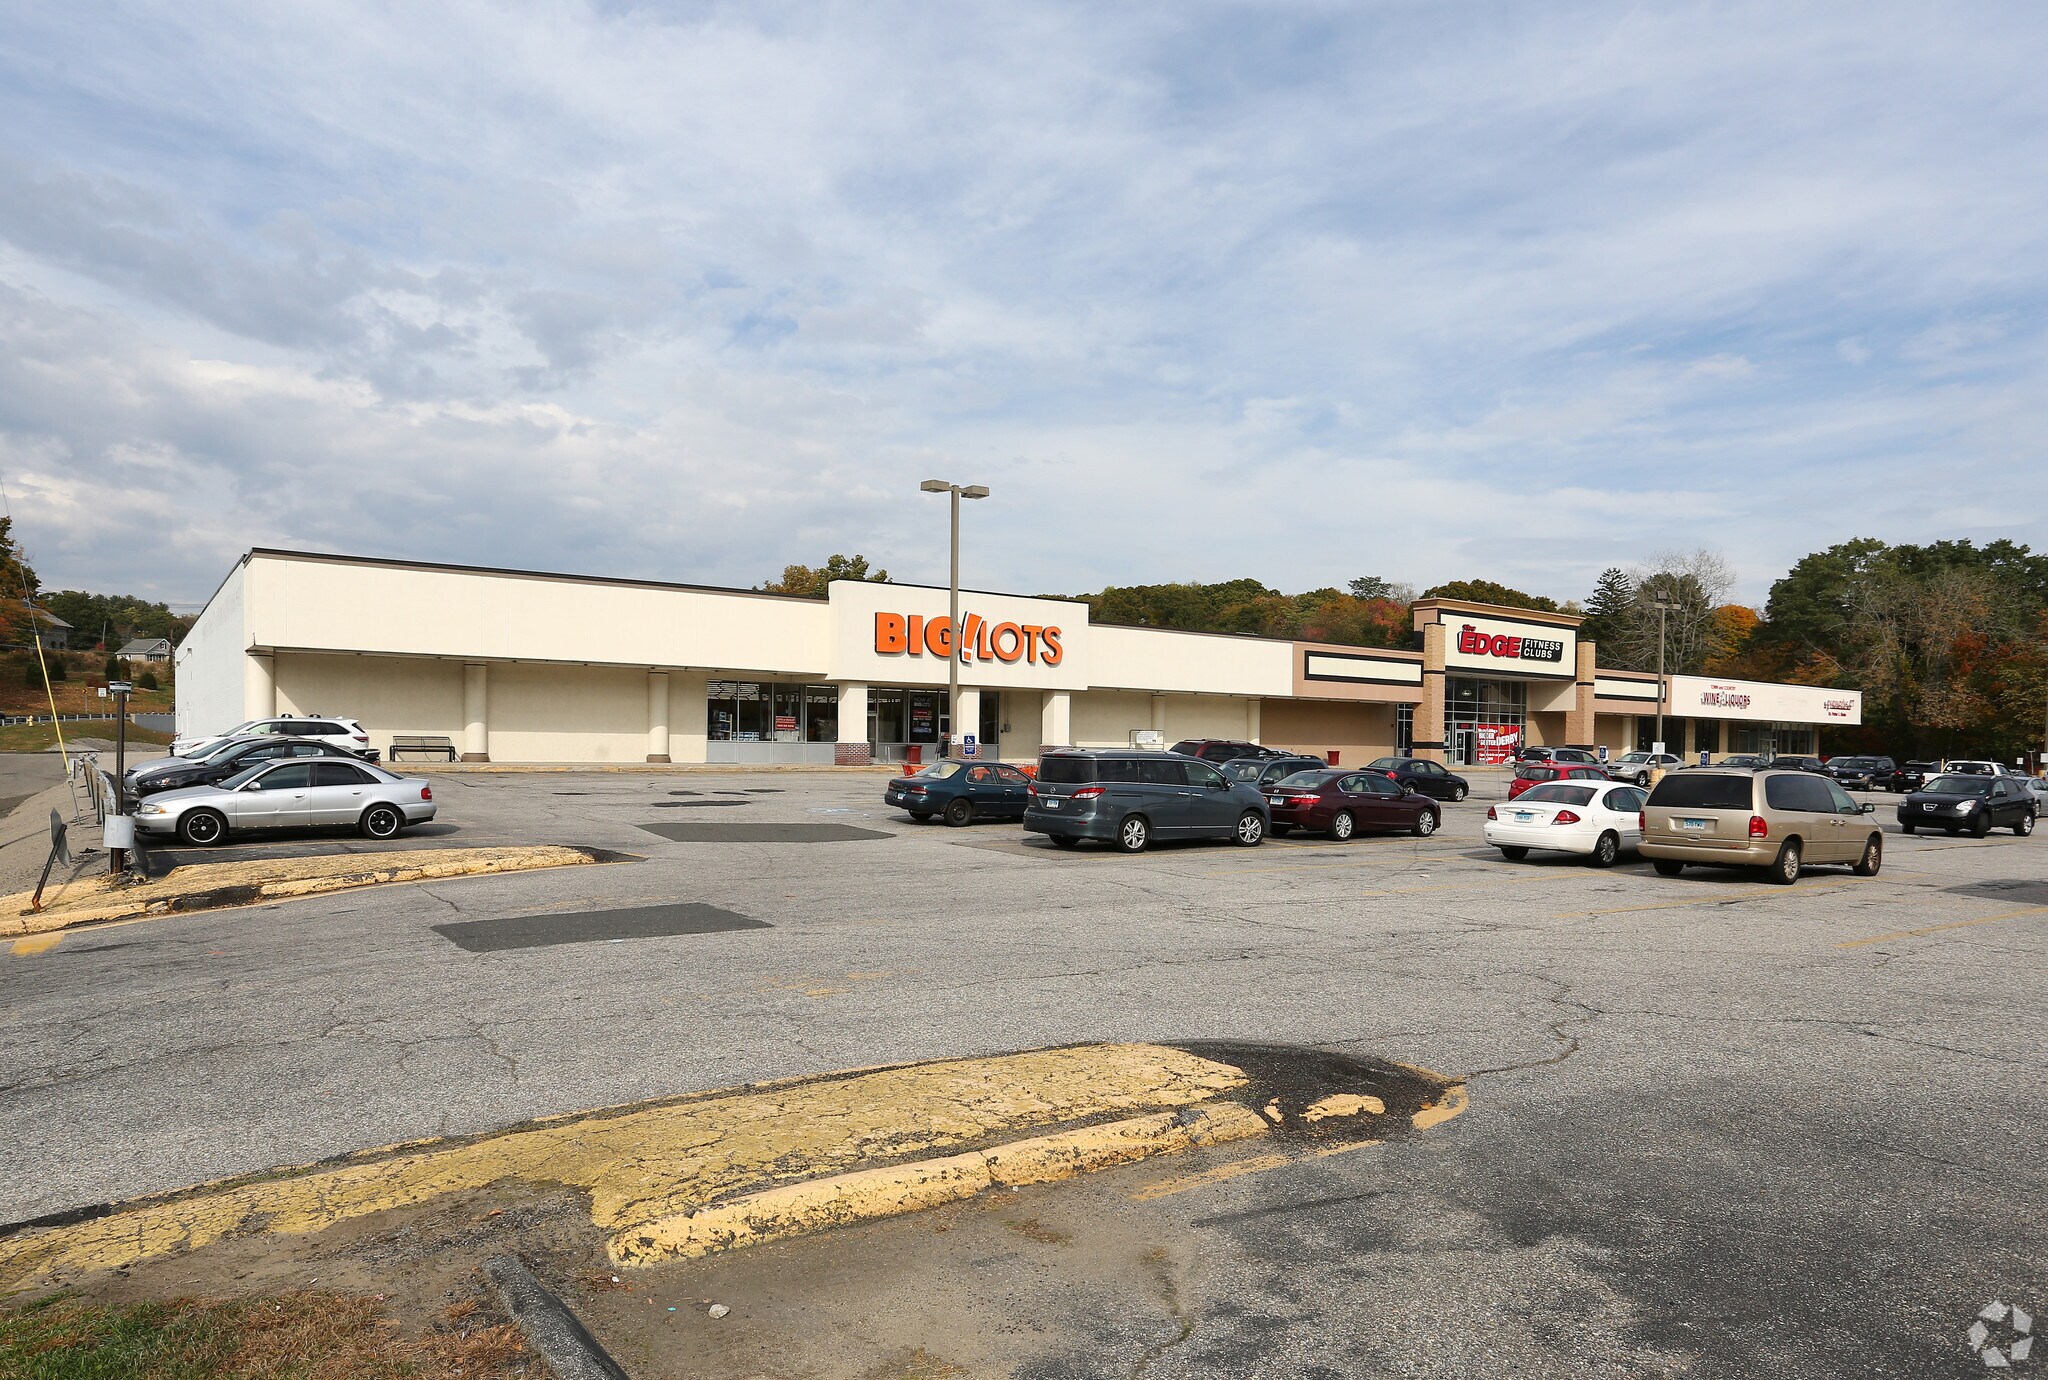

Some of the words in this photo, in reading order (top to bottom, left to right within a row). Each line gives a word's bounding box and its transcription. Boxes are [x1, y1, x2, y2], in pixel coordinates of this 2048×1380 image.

[977, 620, 1064, 664] LOTS
[1460, 631, 1522, 658] EDGE
[1525, 640, 1560, 651] FITNESS
[1523, 648, 1553, 659] CLUBS
[1703, 692, 1720, 704] WINE
[1725, 694, 1750, 706] LIQUORS
[1496, 732, 1518, 746] DERBY
